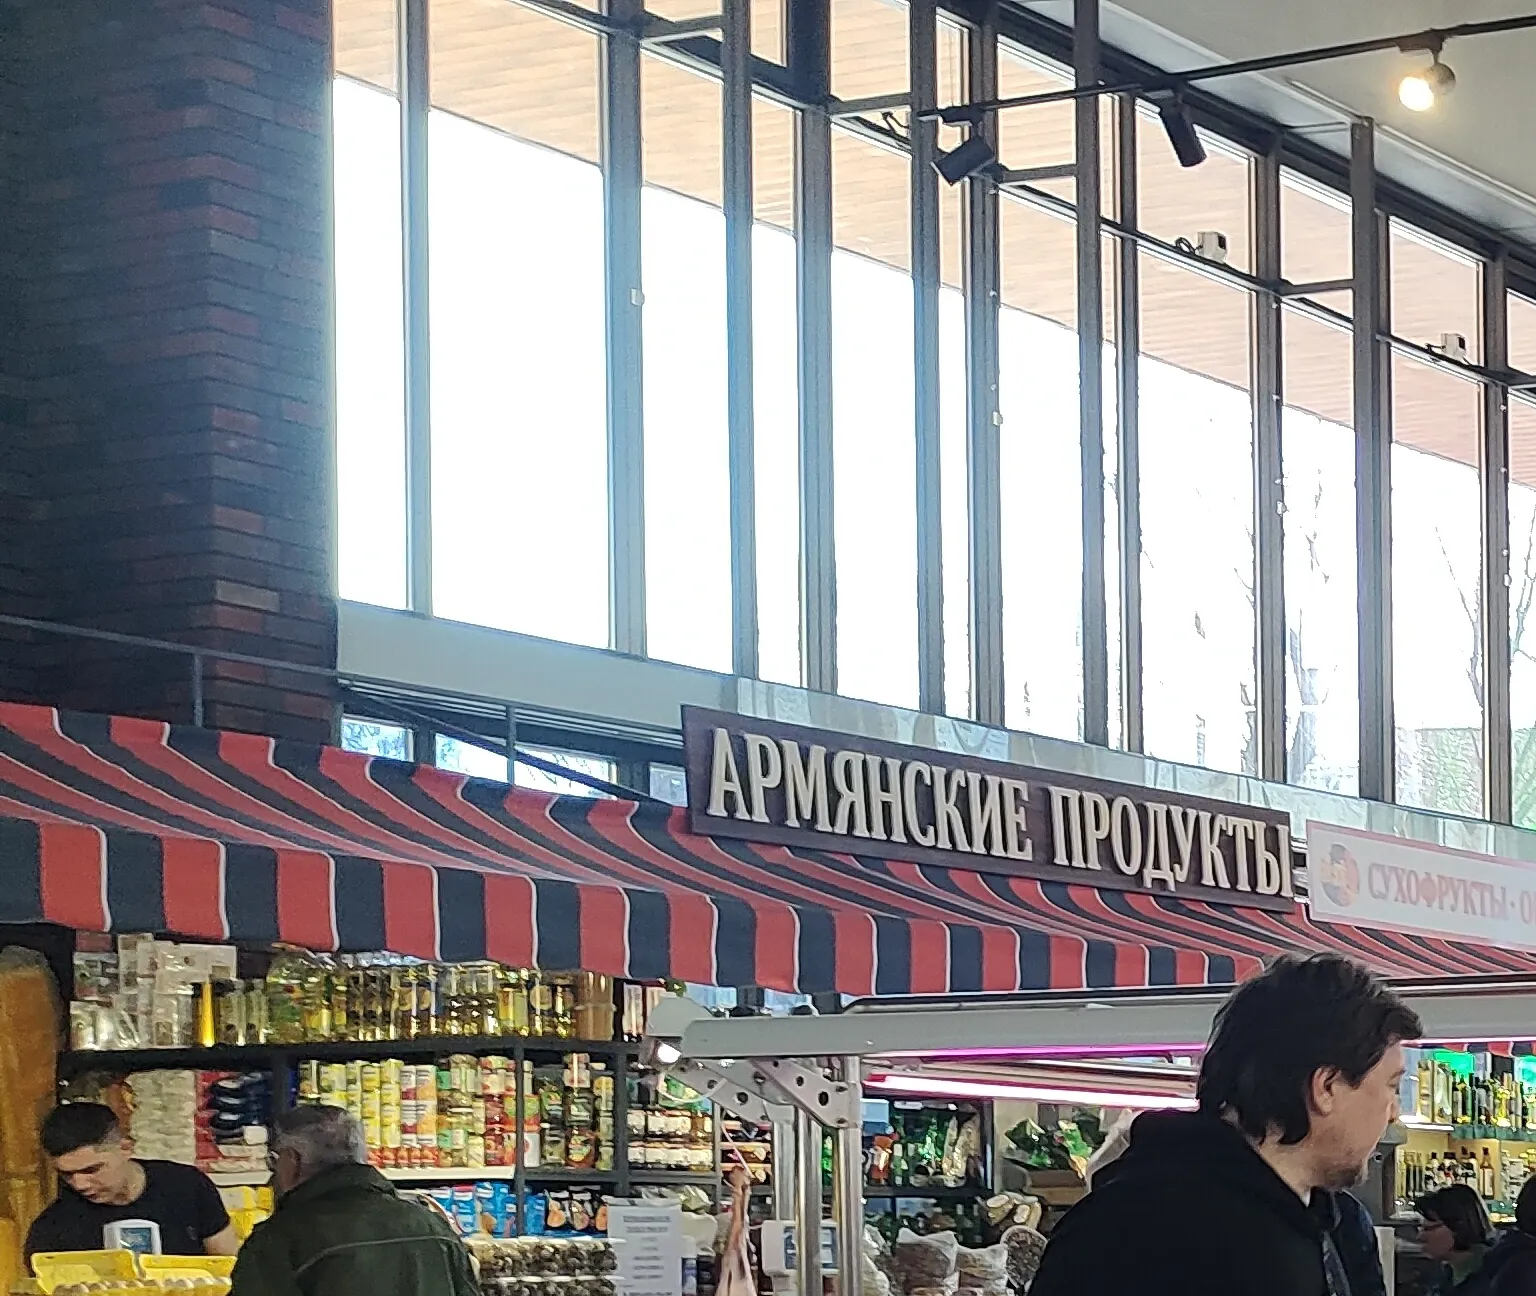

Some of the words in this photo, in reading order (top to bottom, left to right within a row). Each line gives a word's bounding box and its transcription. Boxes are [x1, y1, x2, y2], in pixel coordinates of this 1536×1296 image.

[707, 727, 1033, 862] АРМЯНСКИЕ
[1047, 784, 1293, 899] ПРОДУКТЫ
[1368, 861, 1510, 921] СУХОФРУКТЫ
